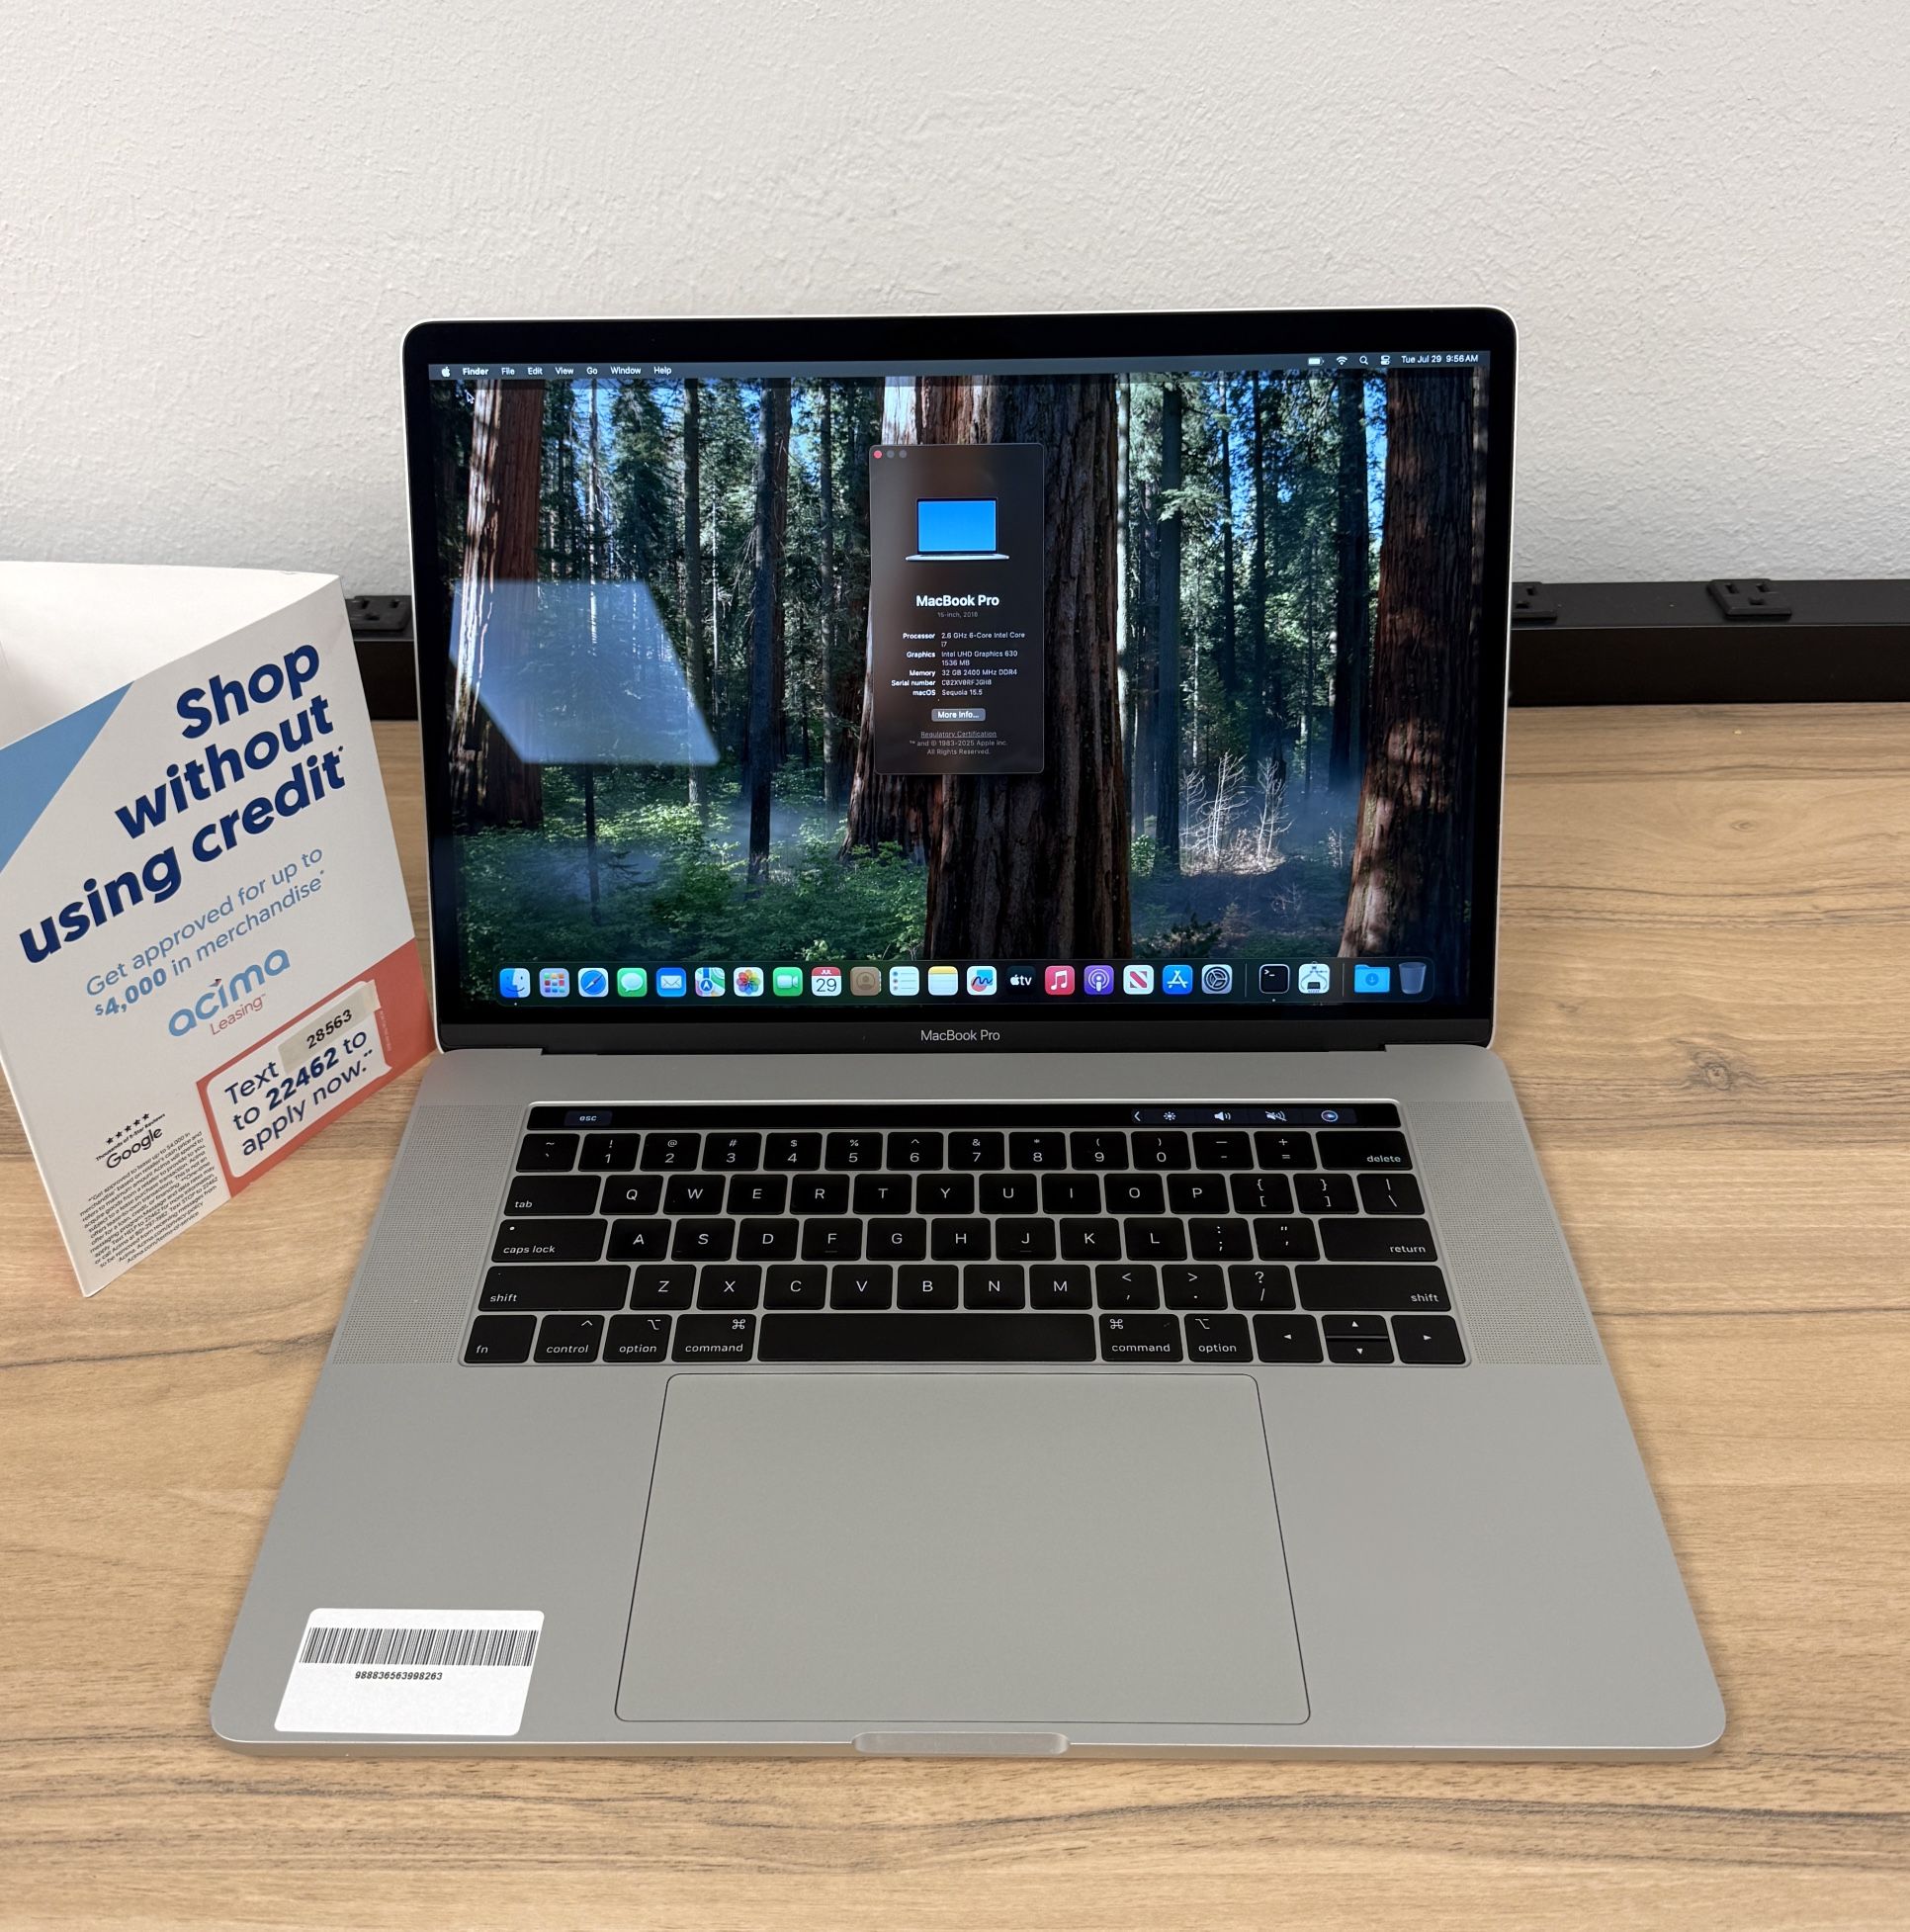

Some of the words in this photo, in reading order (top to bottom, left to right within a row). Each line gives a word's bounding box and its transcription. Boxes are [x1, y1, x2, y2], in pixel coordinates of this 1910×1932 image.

[1401, 355, 1416, 364] Tue
[1417, 354, 1430, 364] Jul
[1431, 354, 1442, 363] 29
[462, 367, 489, 376] Finder
[500, 367, 515, 376] File
[527, 366, 543, 376] Edit
[555, 366, 574, 375] View
[585, 366, 598, 375] Go
[610, 366, 642, 375] Window
[653, 366, 672, 376] Help
[915, 594, 976, 607] MacBook
[977, 593, 1000, 606] Pro
[176, 644, 319, 740] Shop
[937, 710, 958, 719] More
[115, 695, 334, 839] without
[19, 845, 183, 964] using
[86, 963, 128, 997] Get
[131, 895, 234, 971] approved
[237, 879, 267, 906] for
[271, 862, 298, 885] up
[301, 848, 323, 868] to
[95, 967, 167, 1016] $4,000
[171, 956, 192, 977] in
[816, 978, 837, 992] 29
[168, 949, 291, 1037] acima
[305, 1009, 353, 1049] 28563
[920, 1029, 978, 1041] MacBook
[980, 1029, 1000, 1041] Pro
[224, 1061, 279, 1104] Text
[232, 1106, 261, 1131] to
[265, 1046, 339, 1110] 22462
[342, 1031, 367, 1055] to
[242, 1099, 305, 1156] apply
[106, 1128, 163, 1169] Google
[605, 1153, 611, 1164] 1
[664, 1153, 675, 1164] 2
[726, 1152, 737, 1164] 3
[787, 1152, 798, 1163] 4
[848, 1152, 858, 1163] 5
[910, 1152, 919, 1163] 6
[972, 1152, 982, 1163] 7
[1032, 1152, 1043, 1163] 8
[1094, 1151, 1105, 1163] 9
[1156, 1151, 1167, 1163] 0
[626, 1188, 638, 1201] Q
[687, 1188, 704, 1199] W
[752, 1188, 762, 1199] E
[815, 1187, 825, 1199] R
[878, 1187, 889, 1199] T
[940, 1187, 951, 1199] Y
[1002, 1187, 1014, 1199] U
[1128, 1186, 1141, 1198] O
[1191, 1187, 1203, 1198] P
[632, 1233, 645, 1245] A
[697, 1233, 709, 1245] S
[762, 1233, 774, 1245] D
[827, 1233, 837, 1245] F
[891, 1232, 903, 1245] G
[955, 1233, 967, 1245] H
[1020, 1232, 1030, 1244] J
[1084, 1232, 1095, 1244] K
[1150, 1232, 1161, 1244] L
[532, 1245, 556, 1254] lock
[1255, 1271, 1264, 1283] ?
[657, 1280, 670, 1293] Z
[724, 1280, 737, 1292] X
[790, 1279, 802, 1292] C
[855, 1280, 868, 1292] V
[922, 1280, 933, 1292] B
[988, 1280, 1000, 1292] N
[1053, 1280, 1068, 1292] M
[489, 1293, 517, 1302] shift
[1410, 1293, 1439, 1302] shift
[476, 1345, 488, 1354] fn
[546, 1344, 589, 1354] control
[619, 1344, 657, 1355] option
[685, 1343, 743, 1353] command
[1111, 1343, 1171, 1353] command
[1198, 1343, 1237, 1354] option
[354, 1670, 443, 1681] 988836563998263
